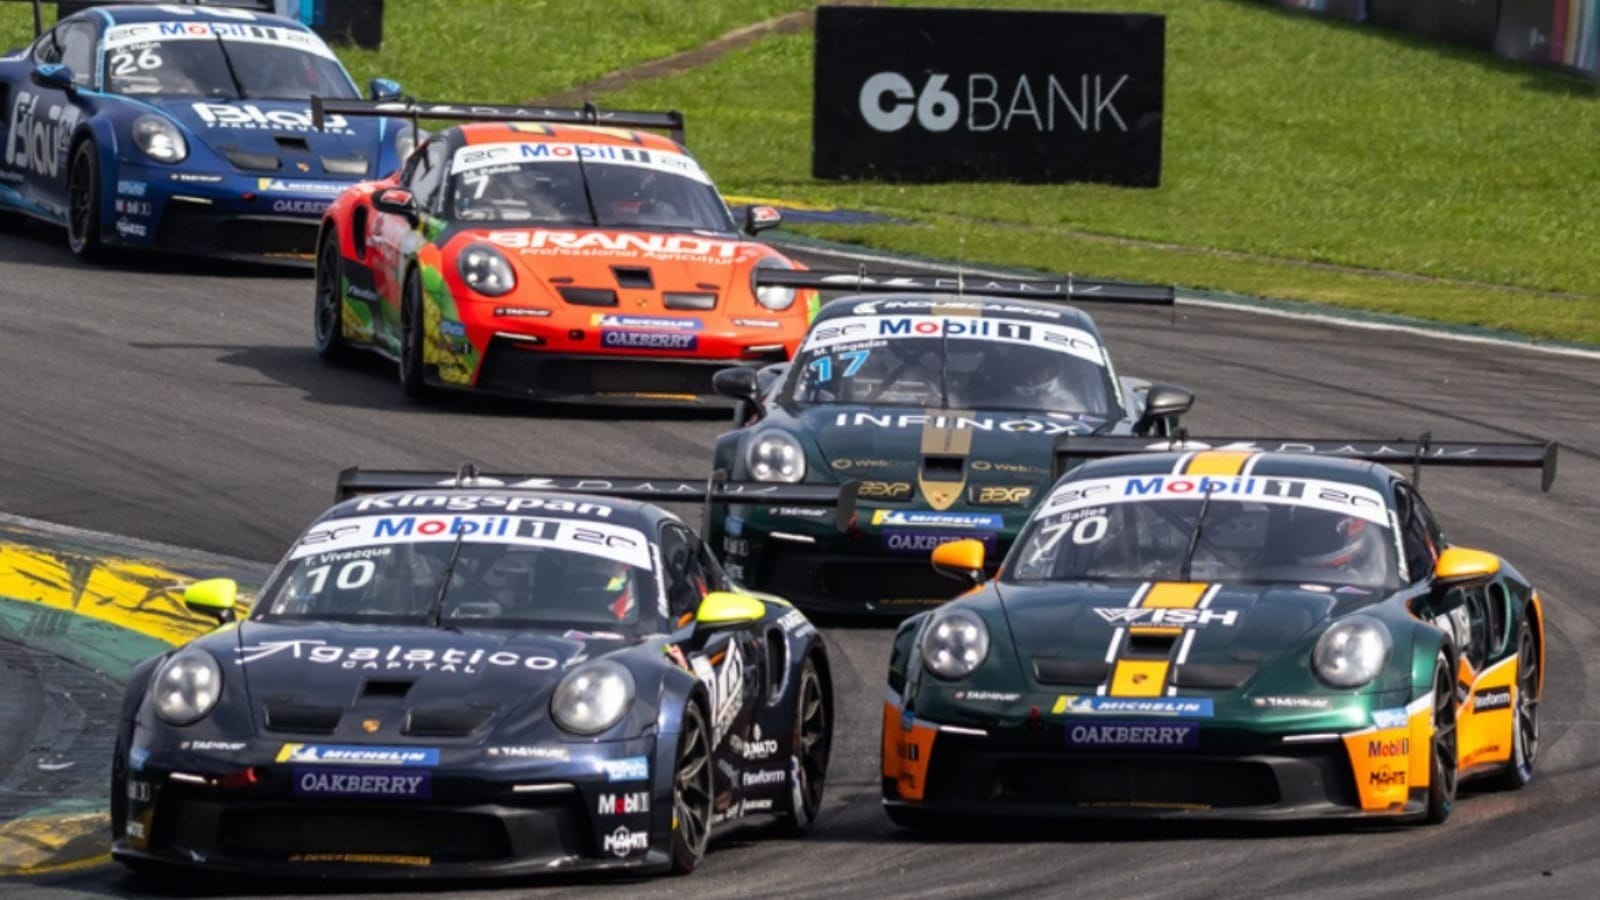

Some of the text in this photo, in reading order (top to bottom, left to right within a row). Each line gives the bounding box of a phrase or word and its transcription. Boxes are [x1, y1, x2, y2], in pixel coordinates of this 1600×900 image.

[159, 21, 246, 37] Mobil
[111, 50, 162, 76] 26
[206, 122, 357, 136] FARMACEUICA
[521, 143, 616, 159] Mobil
[464, 175, 489, 199] 7
[488, 230, 739, 257] BRANDT
[520, 247, 747, 265] Professional Agriculture
[879, 318, 989, 335] Mobil
[606, 331, 692, 348] OAKBERRY
[809, 349, 871, 382] 17
[834, 411, 1080, 436] INFINOX
[1124, 476, 1256, 495] Mobil
[356, 494, 612, 517] Kingspan
[1060, 506, 1107, 523] Salles
[373, 517, 509, 538] Mobil
[909, 514, 992, 525] MICHELIN
[1038, 516, 1109, 553] 70
[305, 547, 391, 566] T. Vivacqua
[306, 560, 376, 595] 10
[1092, 607, 1239, 626] WISH
[342, 659, 476, 674] CAPITAL
[1097, 701, 1202, 713] MICHELIN
[1071, 724, 1191, 745] OAKBERRY
[322, 748, 426, 762] MICHELIN
[300, 772, 423, 795] OAKBERRY
[598, 792, 639, 815] Mobil
